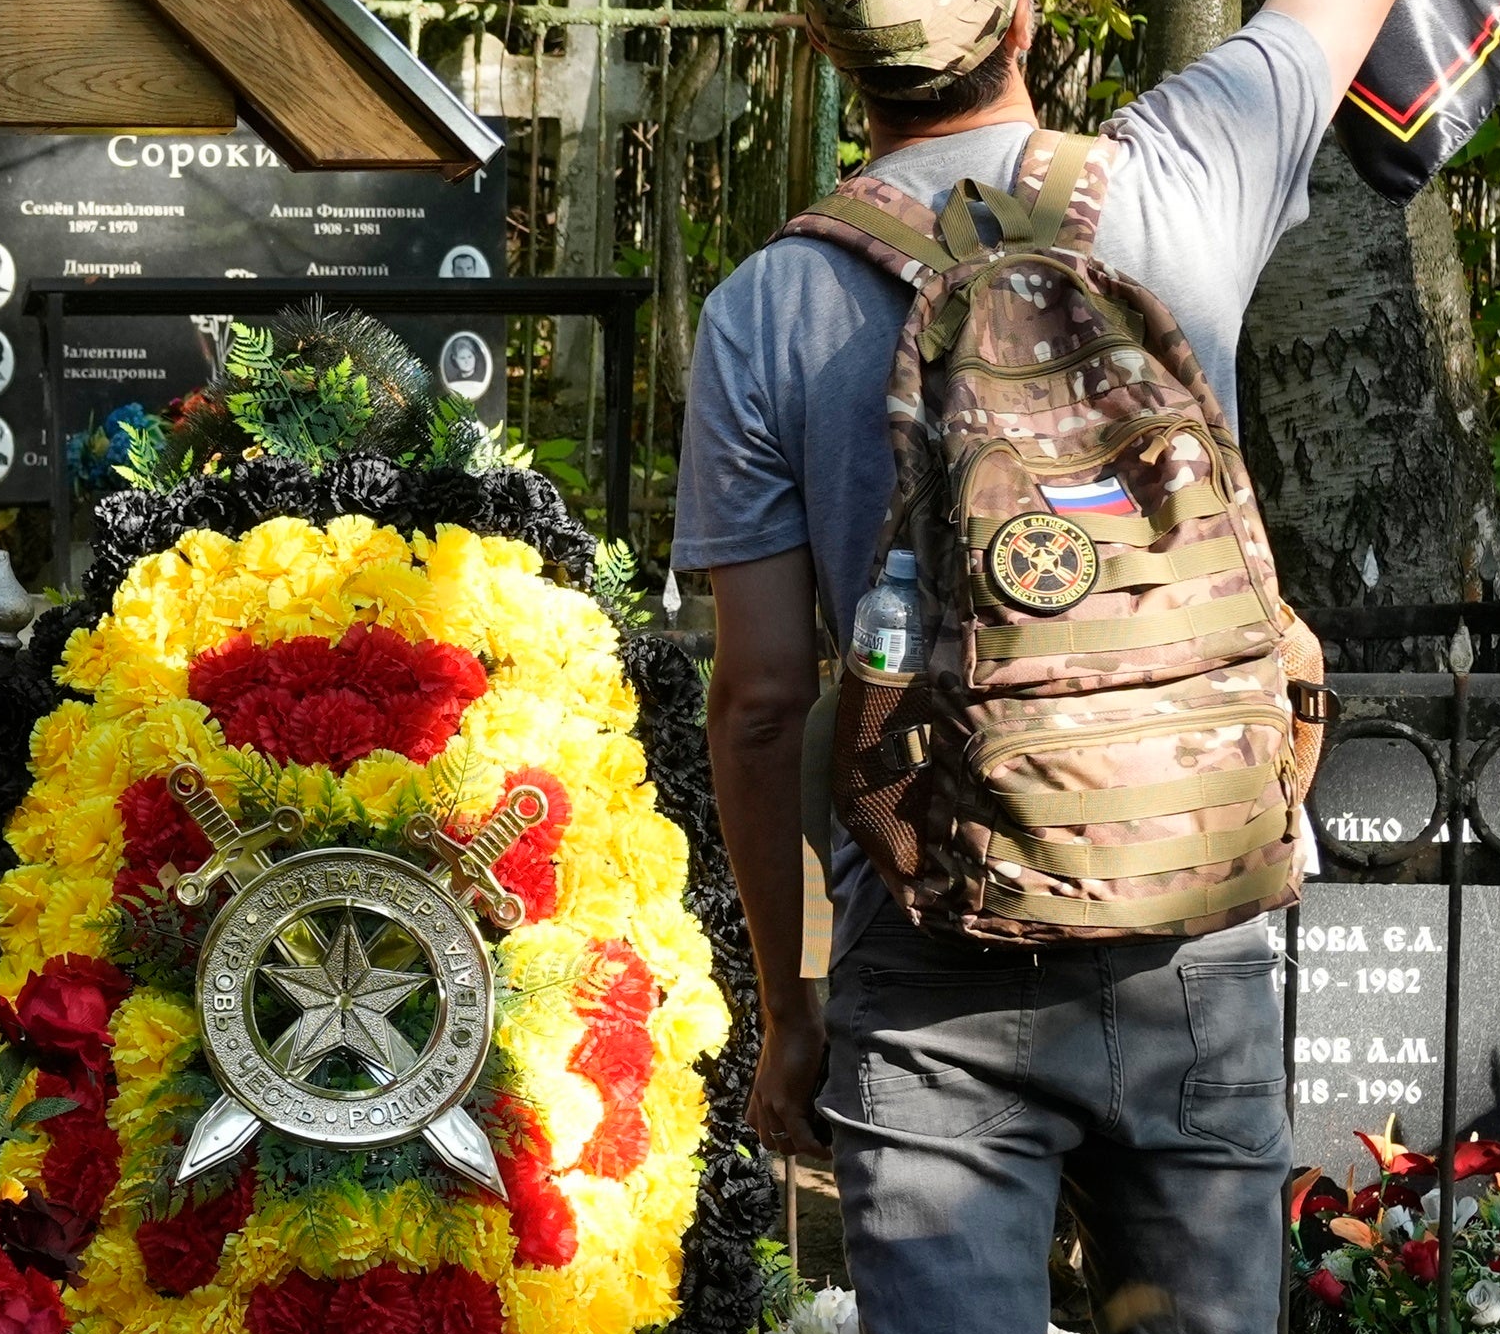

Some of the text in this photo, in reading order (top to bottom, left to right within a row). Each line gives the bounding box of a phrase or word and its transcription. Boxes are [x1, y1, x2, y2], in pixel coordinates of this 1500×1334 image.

[107, 135, 287, 178] Сороки
[20, 200, 185, 217] Семён Михайлович
[270, 203, 425, 219] Анна Филипповна
[108, 221, 138, 233] 1970
[313, 223, 342, 235] 1908
[353, 223, 381, 235] 1981
[63, 259, 142, 278] Дмитрий
[306, 261, 390, 277] Анатолий
[63, 367, 167, 383] ександровна
[1009, 518, 1068, 534] ЧВК ВАГНЕР
[263, 868, 435, 916] ЧВК ВАГНЕР
[212, 934, 251, 1032] КРОВЬ
[445, 939, 478, 1049] ОТВАГА
[1357, 967, 1421, 994] 1982
[1366, 1037, 1438, 1064] А.М.
[237, 1052, 316, 1123] ЧЕСТЬ
[348, 1068, 453, 1130] РОДИНА
[1357, 1078, 1422, 1105] 1996
